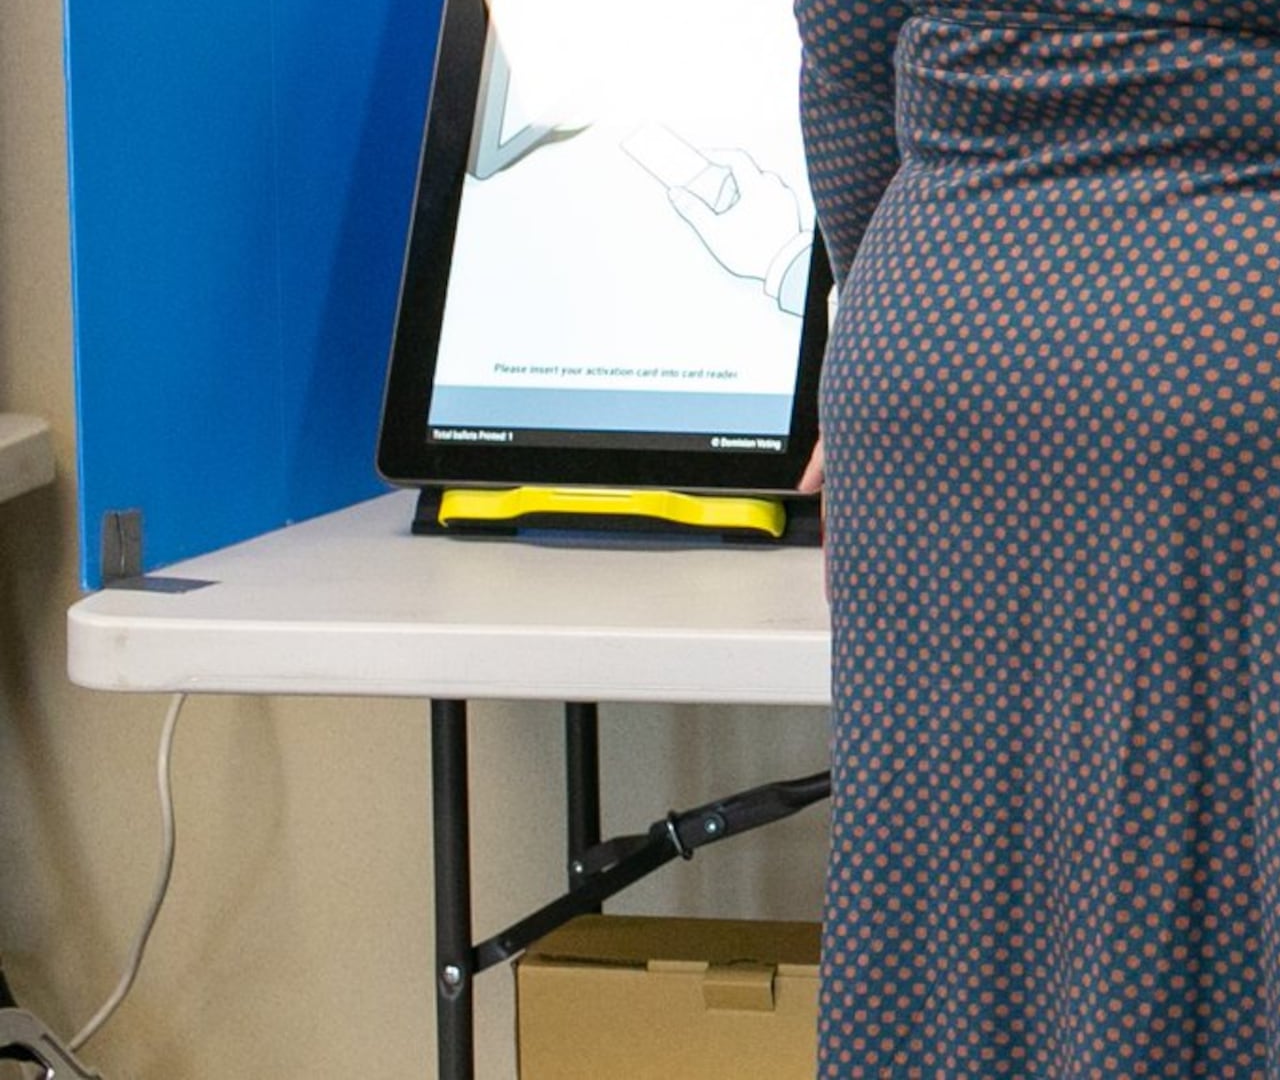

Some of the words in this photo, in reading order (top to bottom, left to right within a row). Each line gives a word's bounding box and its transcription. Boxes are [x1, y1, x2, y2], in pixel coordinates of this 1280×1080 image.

[494, 363, 527, 374] Please
[529, 365, 559, 375] insert
[561, 367, 584, 377] your
[586, 366, 635, 377] activation
[636, 367, 659, 377] card
[660, 368, 680, 378] into
[682, 369, 704, 379] card
[720, 436, 756, 449] Dominion
[757, 438, 782, 451] Voting
